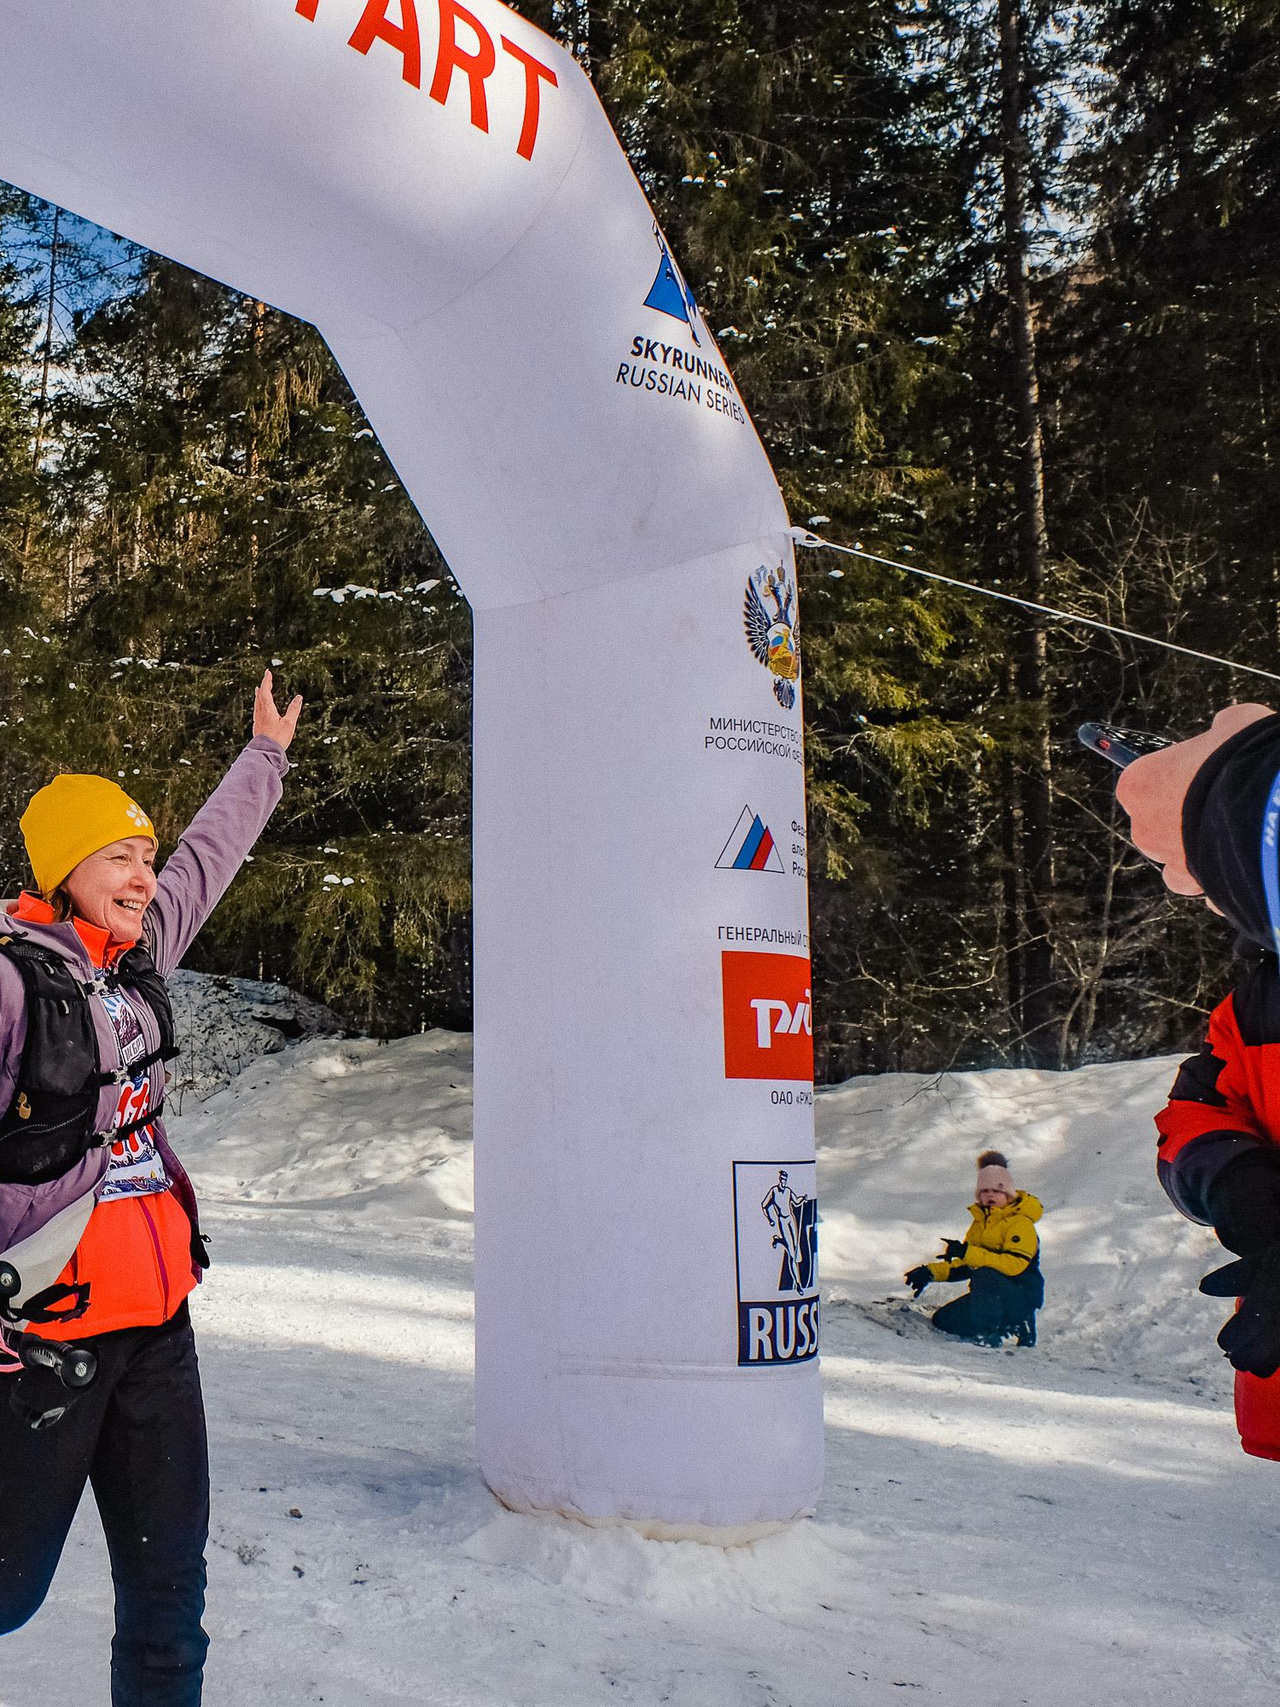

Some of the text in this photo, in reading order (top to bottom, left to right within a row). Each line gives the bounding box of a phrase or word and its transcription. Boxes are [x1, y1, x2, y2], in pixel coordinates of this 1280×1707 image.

[295, 0, 559, 162] ART
[615, 362, 745, 425] RUSSIAN SERIES
[705, 736, 791, 759] РОССИЙСКОЙ
[718, 926, 802, 946] ГЕНЕРАЛЬНЫЙ
[770, 1090, 793, 1105] ОАО
